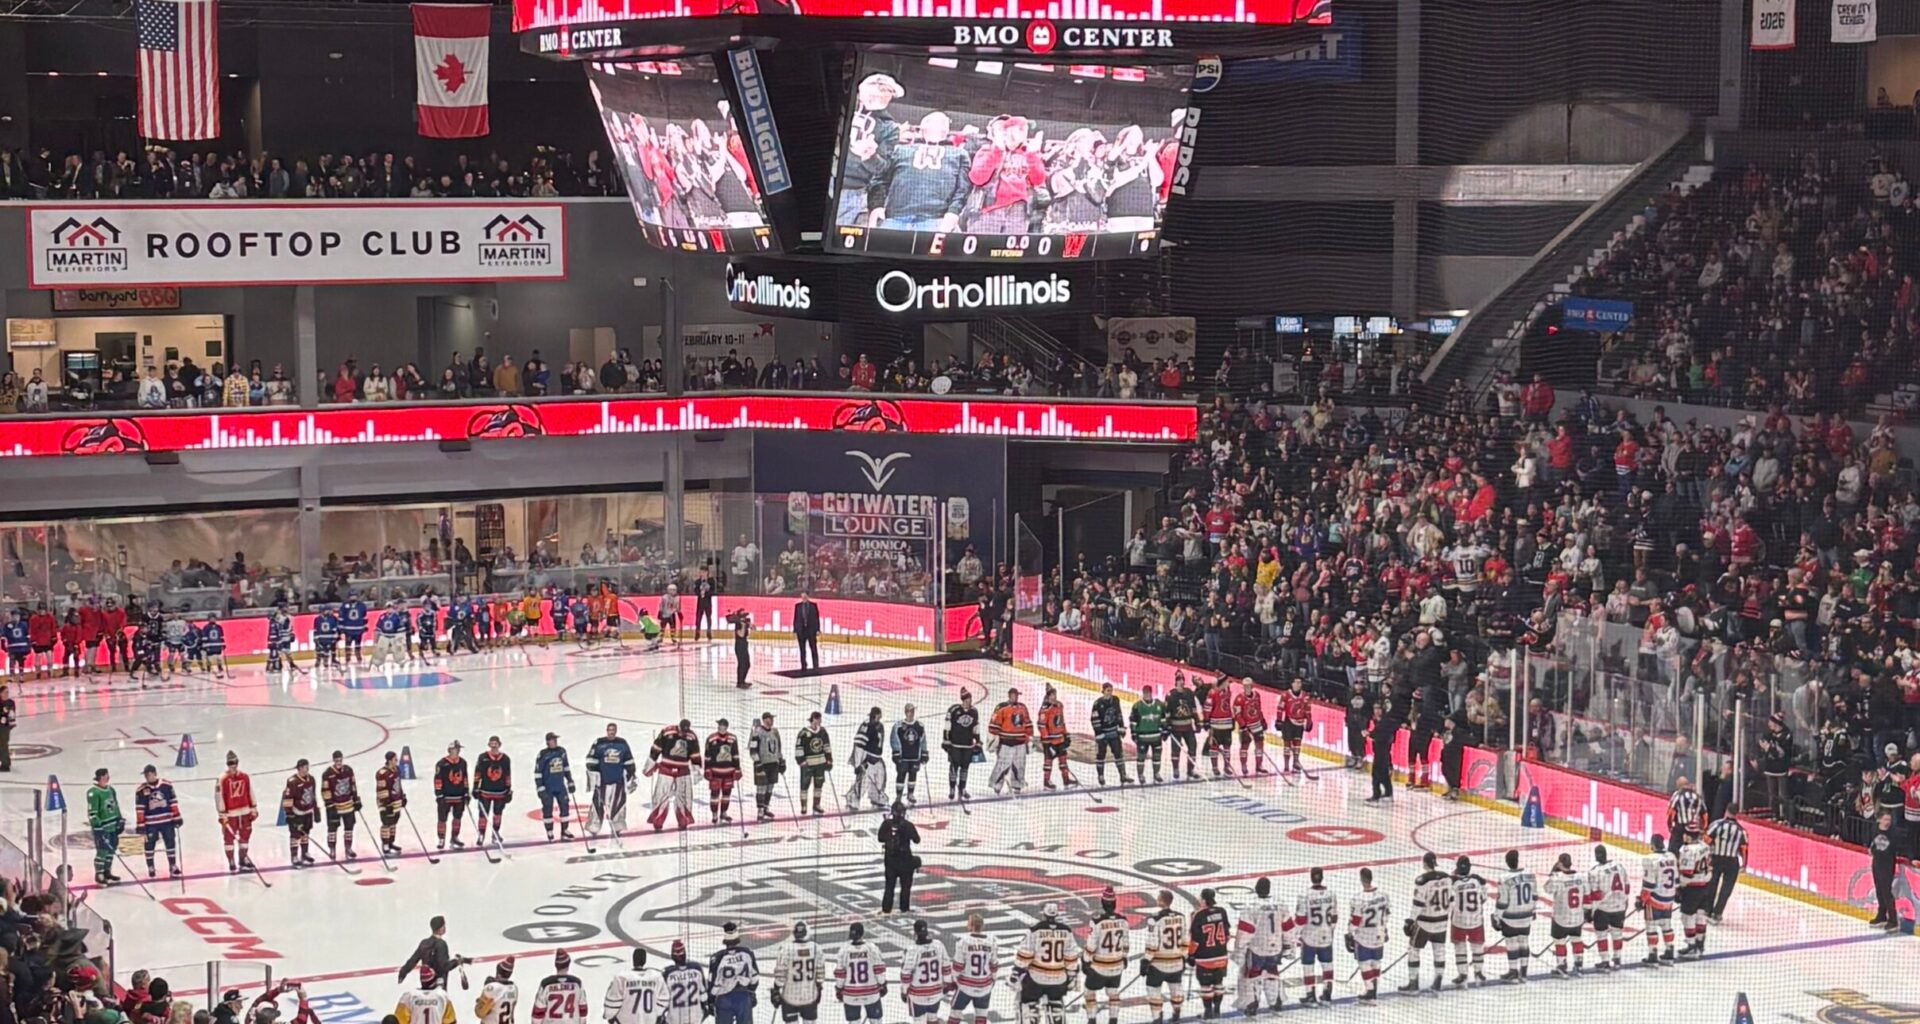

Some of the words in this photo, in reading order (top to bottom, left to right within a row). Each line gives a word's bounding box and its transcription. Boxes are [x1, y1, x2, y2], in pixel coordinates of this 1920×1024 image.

[1760, 12, 1785, 29] 2026
[571, 28, 622, 49] CENTER
[953, 26, 1019, 45] BMO
[1063, 28, 1174, 47] CENTER
[1199, 64, 1219, 74] PSI
[735, 50, 763, 107] BUD
[751, 108, 786, 183] LIGHT
[1171, 107, 1201, 195] PEPSI
[146, 231, 341, 258] ROOFTOP
[362, 230, 461, 256] CLUB
[844, 235, 855, 248] 0
[963, 236, 977, 254] 0
[1006, 236, 1029, 249] 0.0
[1038, 237, 1051, 255] 0
[1141, 239, 1149, 252] 0
[52, 252, 122, 266] MARTIN
[483, 248, 546, 260] MARTIN
[726, 262, 810, 309] OrthoIllinois
[876, 271, 1070, 312] OrthoIllinois
[80, 288, 137, 307] Barnyard
[139, 286, 178, 306] BBQ
[1595, 311, 1628, 321] CENTER
[682, 334, 722, 345] FEBRUARY
[831, 516, 924, 535] LOUNGE
[1456, 559, 1475, 575] 10
[1208, 795, 1308, 823] BMO
[1611, 872, 1624, 891] 4
[1662, 868, 1675, 889] 3
[1430, 888, 1450, 911] 40
[1458, 891, 1478, 912] 19
[1515, 883, 1531, 905] 10
[1567, 887, 1580, 908] 6
[1267, 912, 1276, 933] 1
[1310, 906, 1334, 927] 56
[1364, 905, 1386, 927] 27
[159, 897, 285, 960] CCM
[1162, 926, 1183, 950] 38
[1202, 921, 1226, 947] 74
[1040, 940, 1065, 963] 30
[1101, 929, 1124, 953] 42
[792, 959, 815, 982] 39
[849, 960, 869, 985] 18
[918, 959, 940, 984] 39
[970, 953, 988, 976] 91
[629, 989, 653, 1014] 70
[670, 981, 698, 1009] 22
[422, 1007, 431, 1024] 1
[548, 993, 576, 1019] 24
